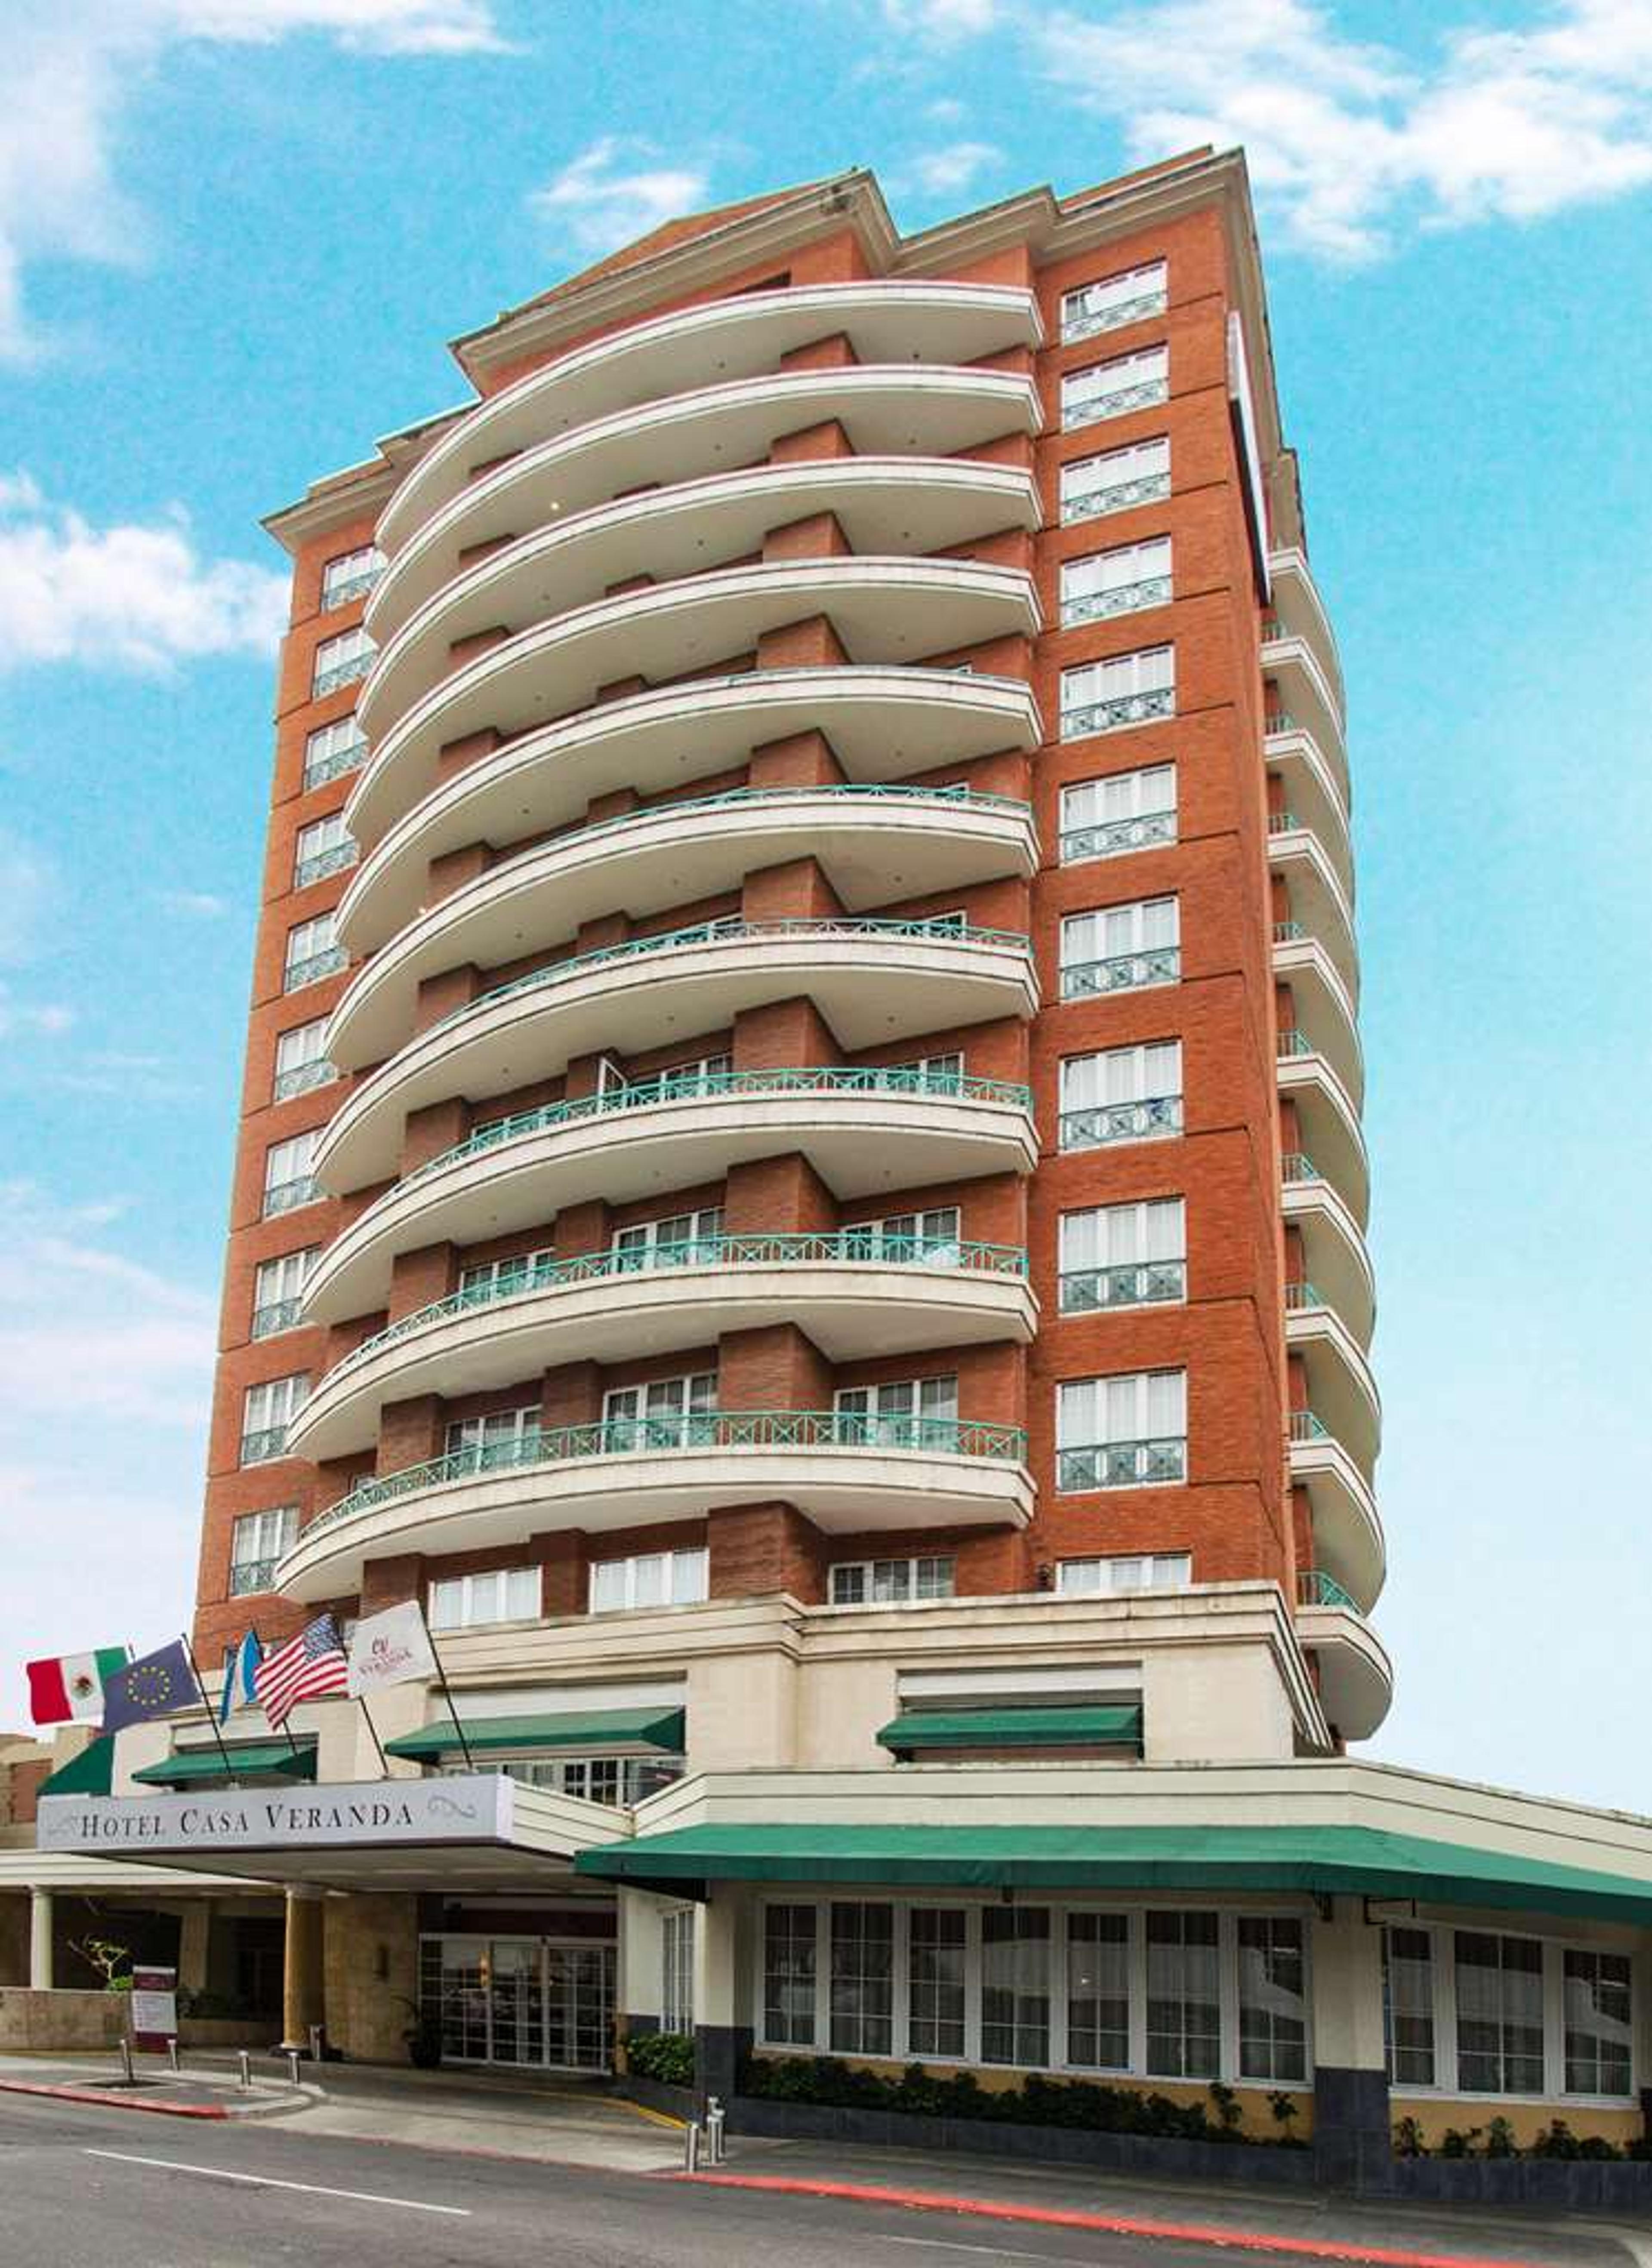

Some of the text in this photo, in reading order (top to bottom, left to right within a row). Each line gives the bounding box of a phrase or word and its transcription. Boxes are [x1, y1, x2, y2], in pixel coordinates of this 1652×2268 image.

[82, 1803, 412, 1837] HOTEL CASA VERANDA
